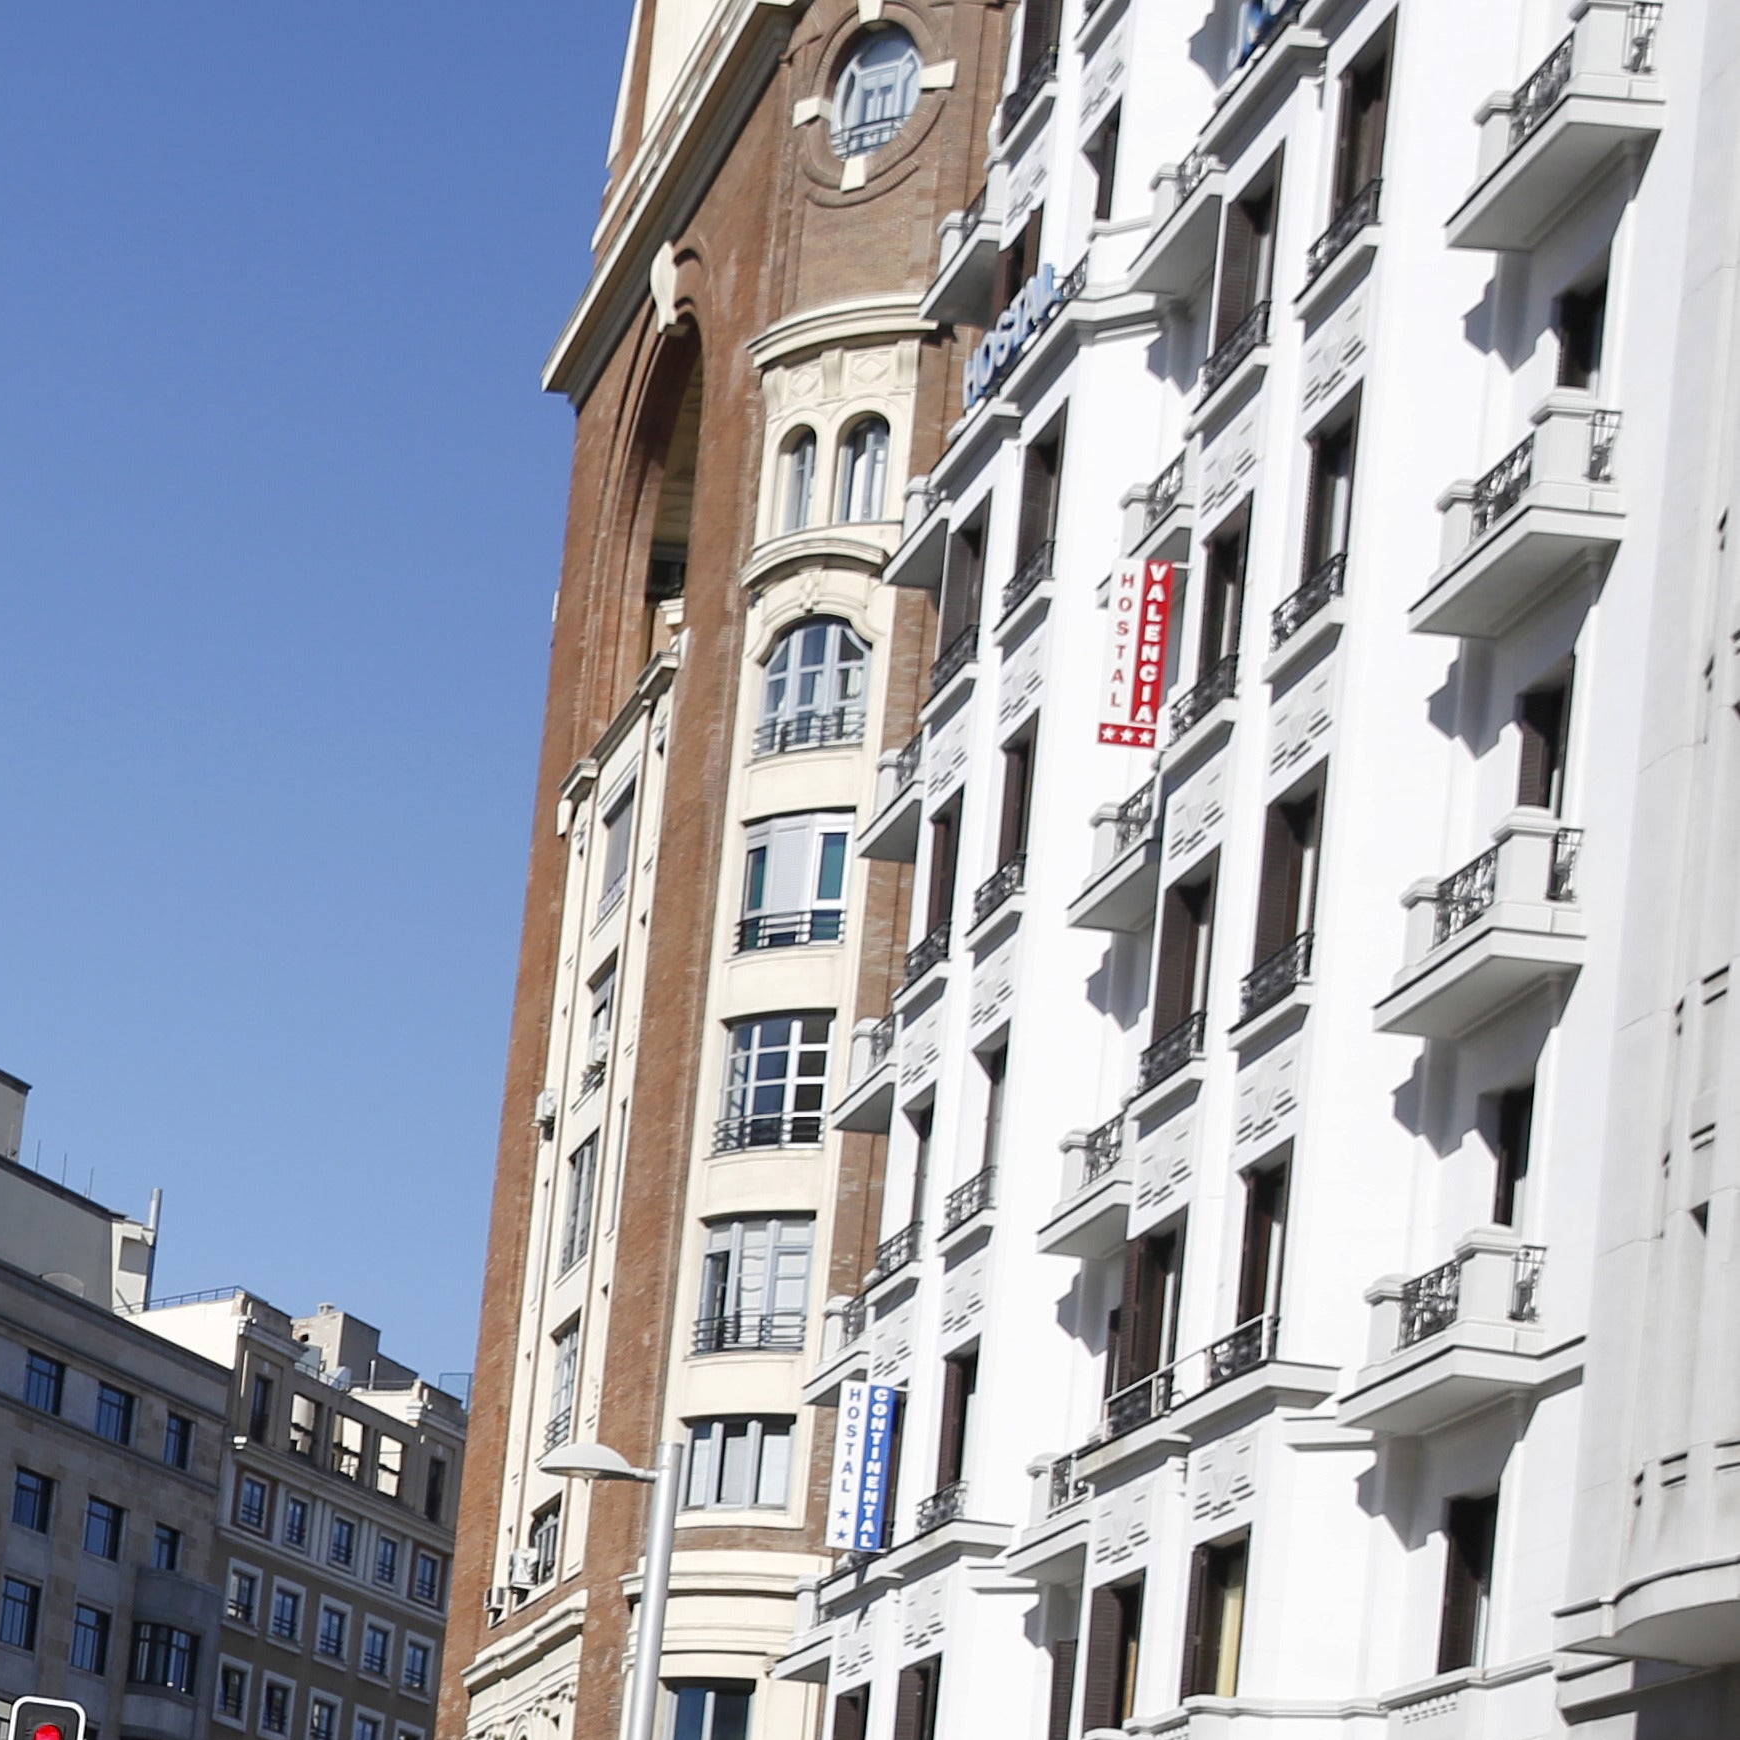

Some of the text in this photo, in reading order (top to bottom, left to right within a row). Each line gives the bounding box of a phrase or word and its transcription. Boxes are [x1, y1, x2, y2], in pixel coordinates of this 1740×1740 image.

[1110, 573, 1135, 709] HOSTAL
[1135, 563, 1171, 723] VALENCIA
[840, 1387, 863, 1495] HOSTAL
[858, 1386, 890, 1550] CONTINENTAL
